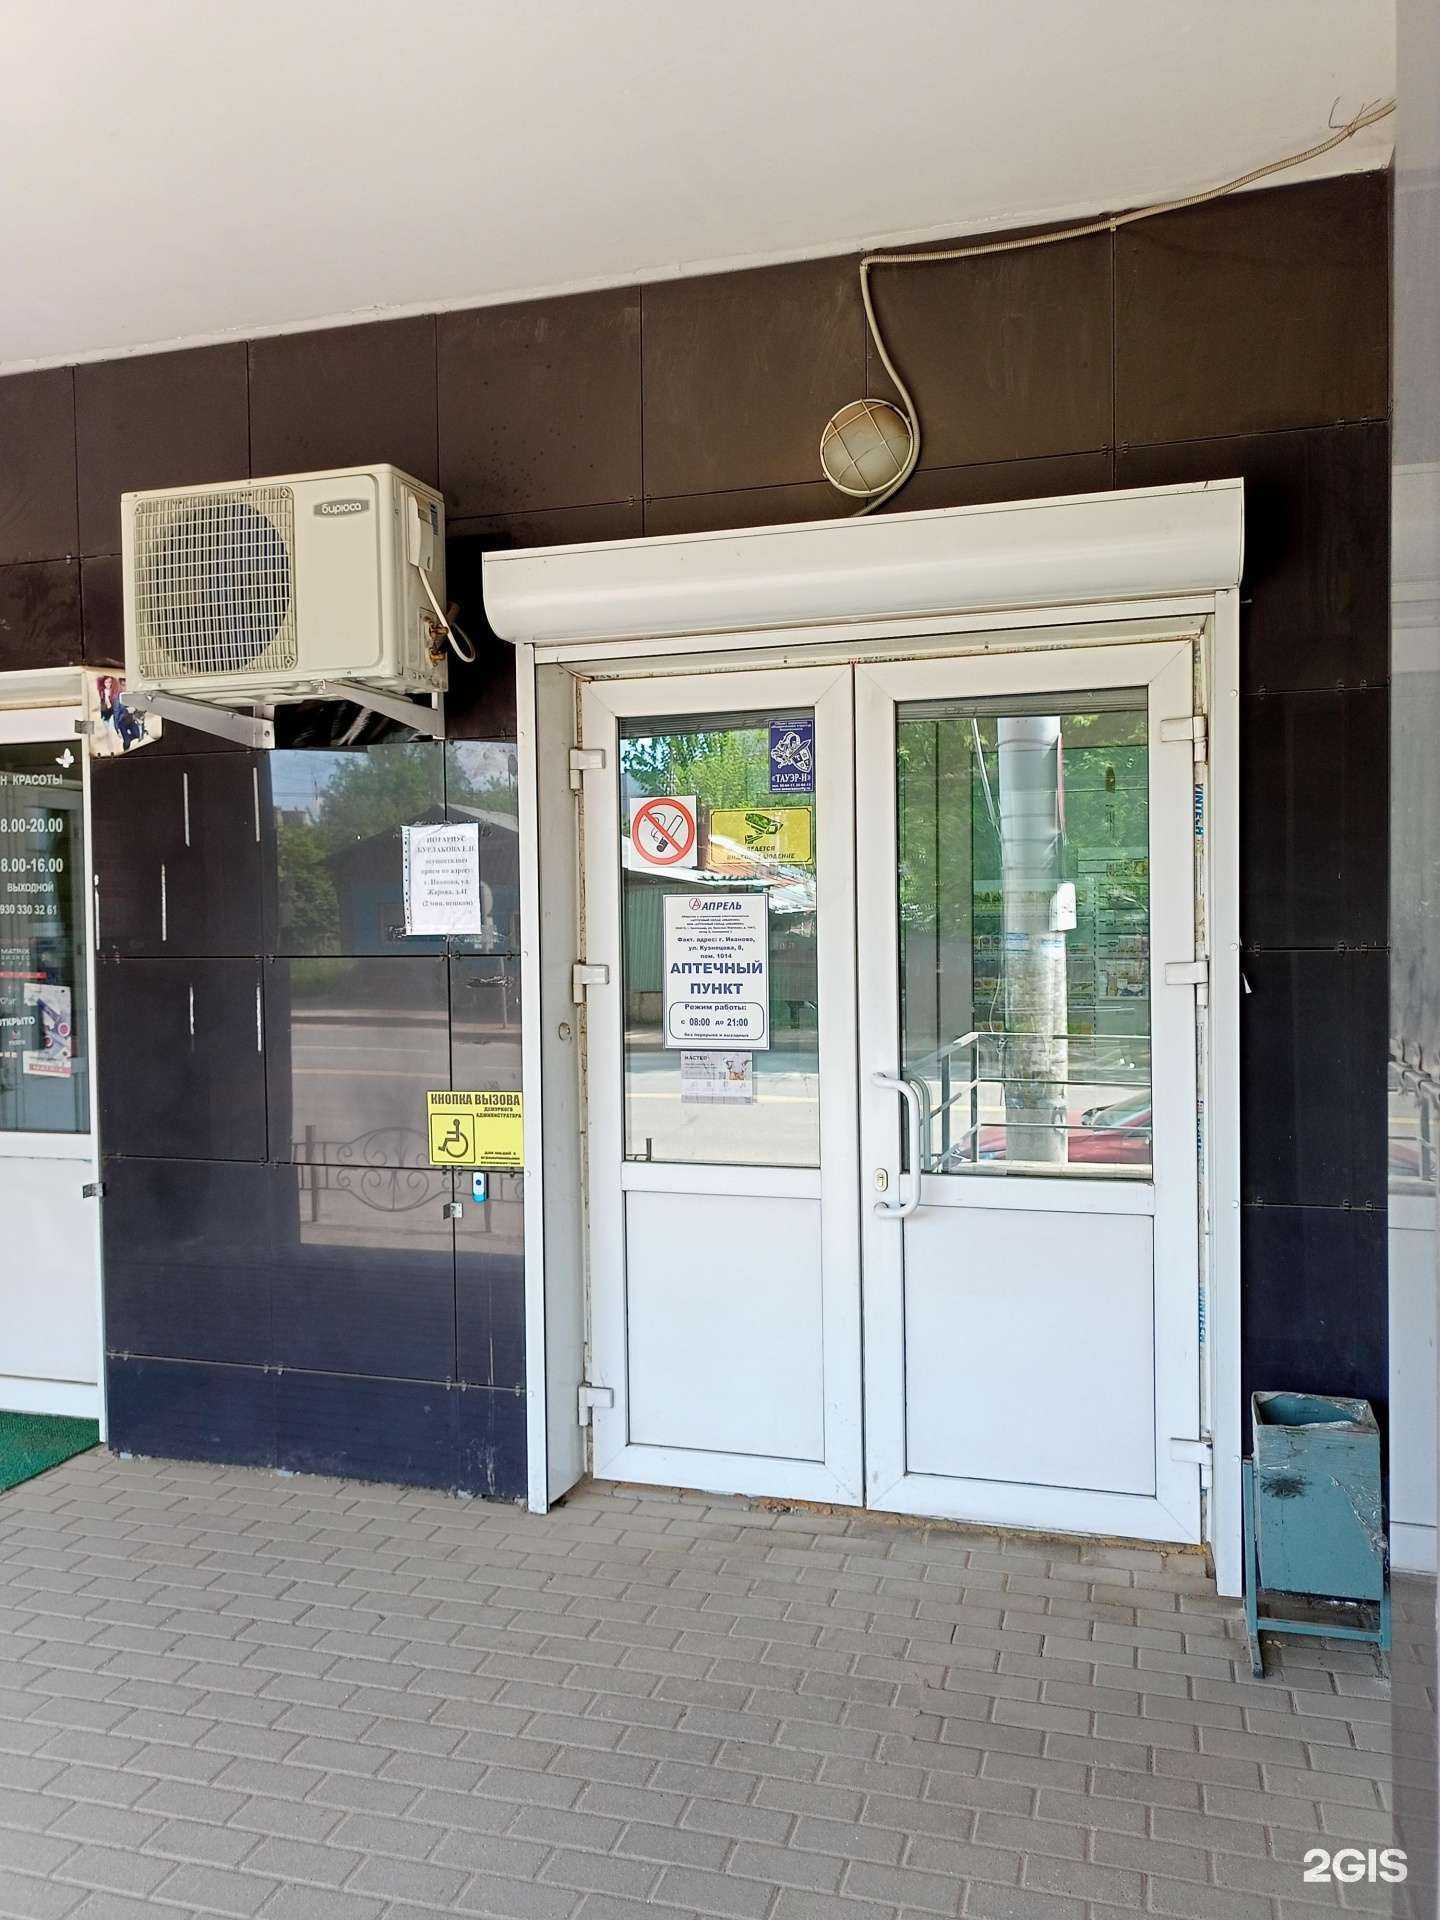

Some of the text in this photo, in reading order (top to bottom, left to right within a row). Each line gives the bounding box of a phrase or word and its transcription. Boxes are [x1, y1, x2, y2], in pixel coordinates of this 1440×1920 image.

[12, 774, 63, 785] КРАСОТЫ
[0, 818, 63, 832] 8.00-20.00
[0, 858, 64, 873] 8.00-16.00
[17, 905, 32, 914] 330
[34, 905, 45, 914] 32
[47, 905, 57, 915] 61
[701, 901, 742, 910] АПРЕЛЬ
[670, 960, 763, 974] АПТЕЧНЫЙ
[690, 983, 743, 995] ПУНКТ
[689, 1018, 710, 1026] 08:00
[727, 1018, 748, 1026] 21:00
[431, 1094, 520, 1106] КНОПКА ВЫЗОВА
